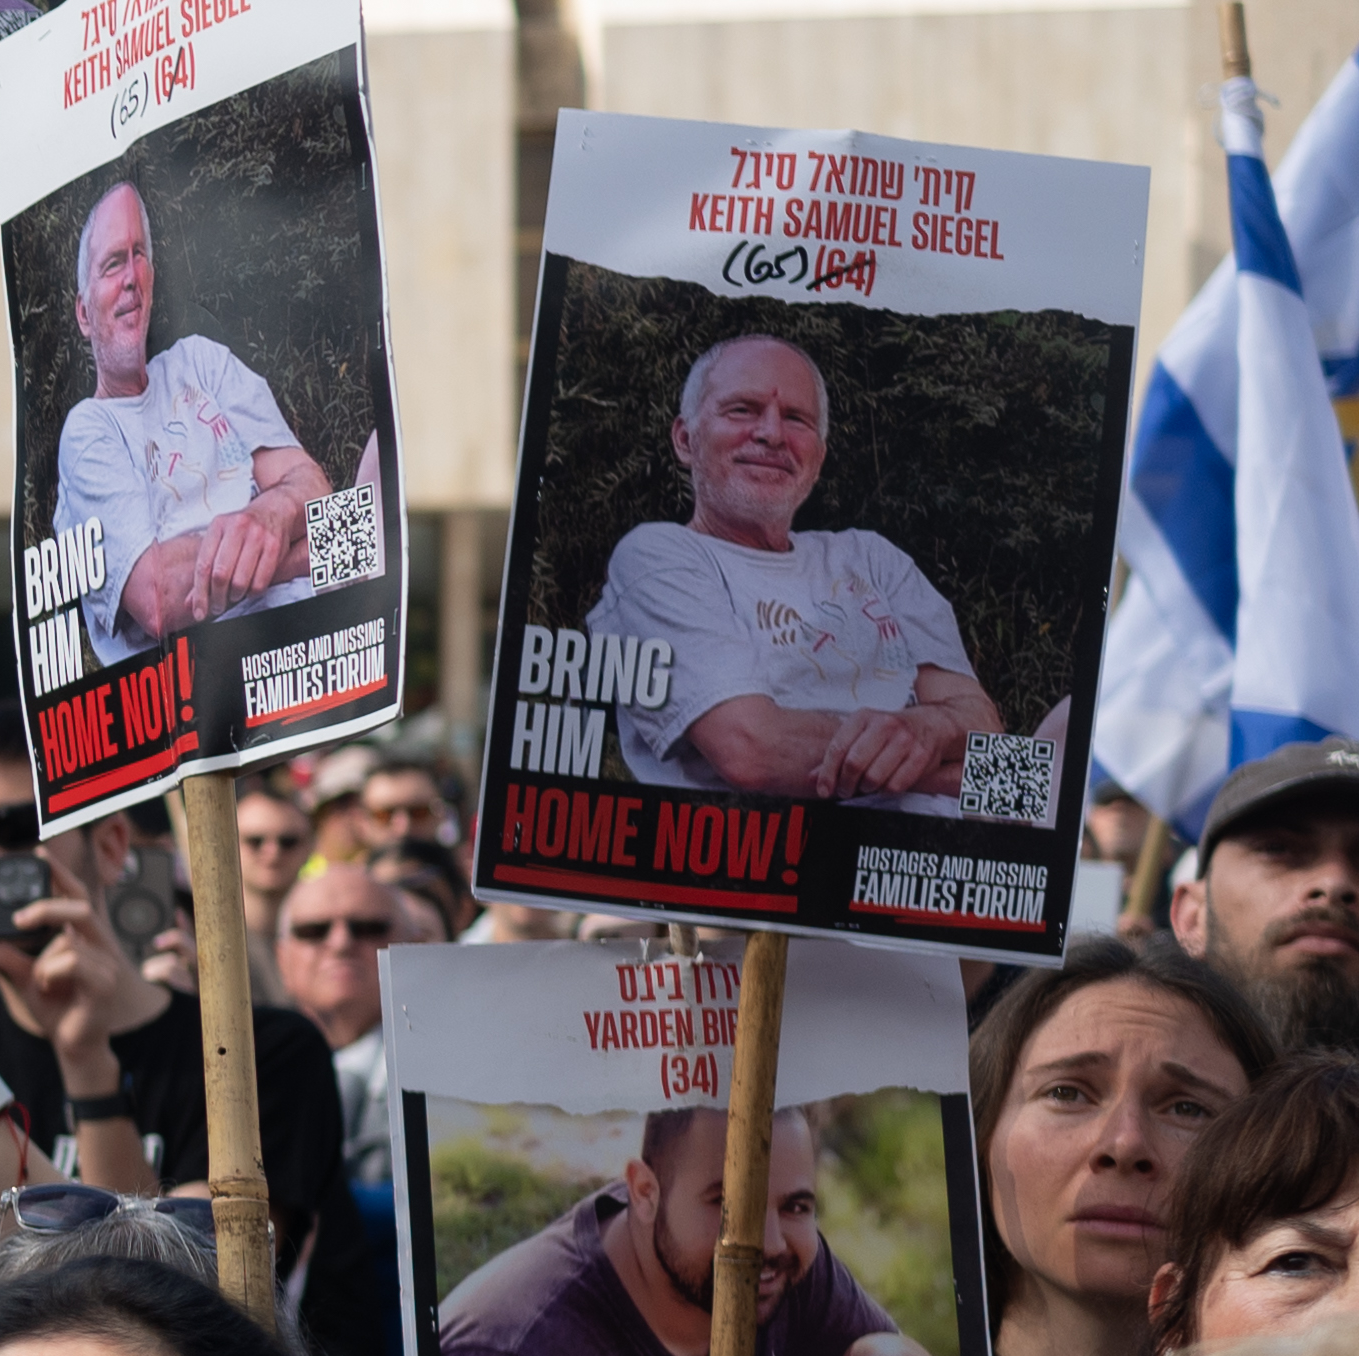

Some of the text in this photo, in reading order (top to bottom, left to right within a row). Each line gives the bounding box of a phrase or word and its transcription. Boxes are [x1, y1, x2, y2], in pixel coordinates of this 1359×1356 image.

[64, 50, 112, 110] KEITH
[115, 6, 176, 79] SAMUEL
[111, 73, 148, 139] (65)
[730, 146, 796, 191] סיגל
[808, 149, 904, 202] שמואל
[689, 192, 1004, 261] KEITH SAMUEL SIEGEL
[23, 516, 105, 619] BRING
[29, 607, 83, 698] HIM
[242, 618, 385, 682] HOSTAGES AND MISSING
[245, 644, 385, 719] FAMILIES FORUM
[517, 623, 674, 709] BRING
[38, 683, 118, 783] HOME
[509, 700, 607, 779] HIM
[501, 783, 810, 886] HOME NOW!
[857, 844, 1049, 889] HOSTAGES AND MISSING
[853, 870, 1047, 924] FAMILIES FORUM
[583, 1007, 738, 1050] YARDEN BIB
[660, 1051, 719, 1100] (34)
